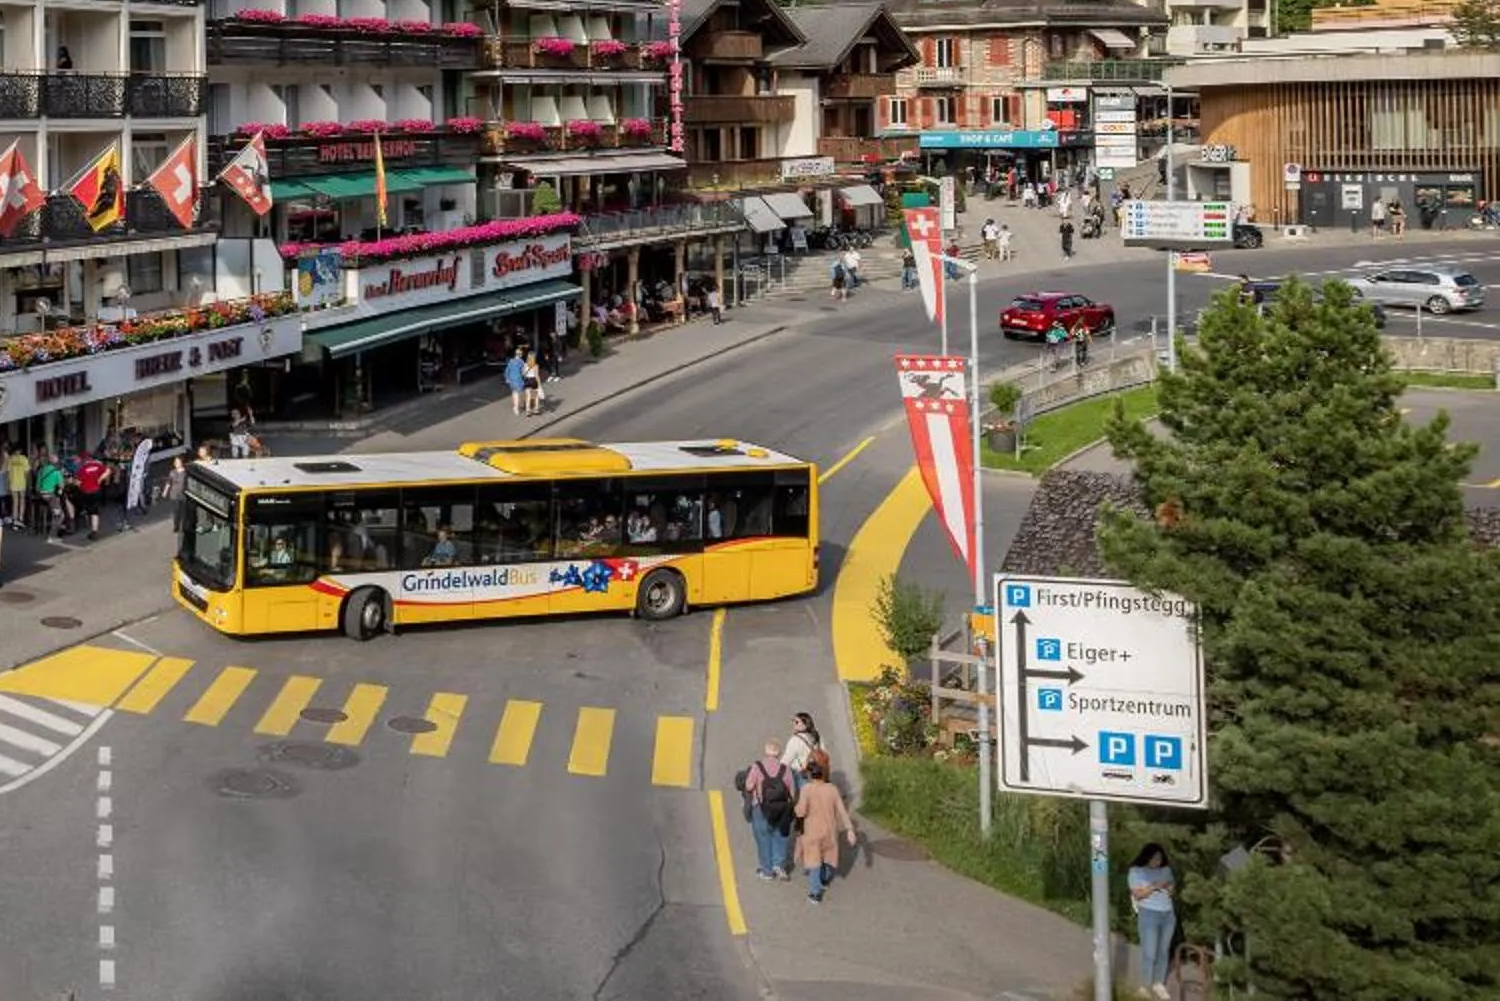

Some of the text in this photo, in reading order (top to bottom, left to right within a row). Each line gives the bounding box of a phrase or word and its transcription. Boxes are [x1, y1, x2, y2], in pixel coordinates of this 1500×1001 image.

[1037, 589, 1186, 617] First/Pfingstegg
[1067, 642, 1132, 665] Eiger+
[1069, 692, 1191, 718] Sportzentrum
